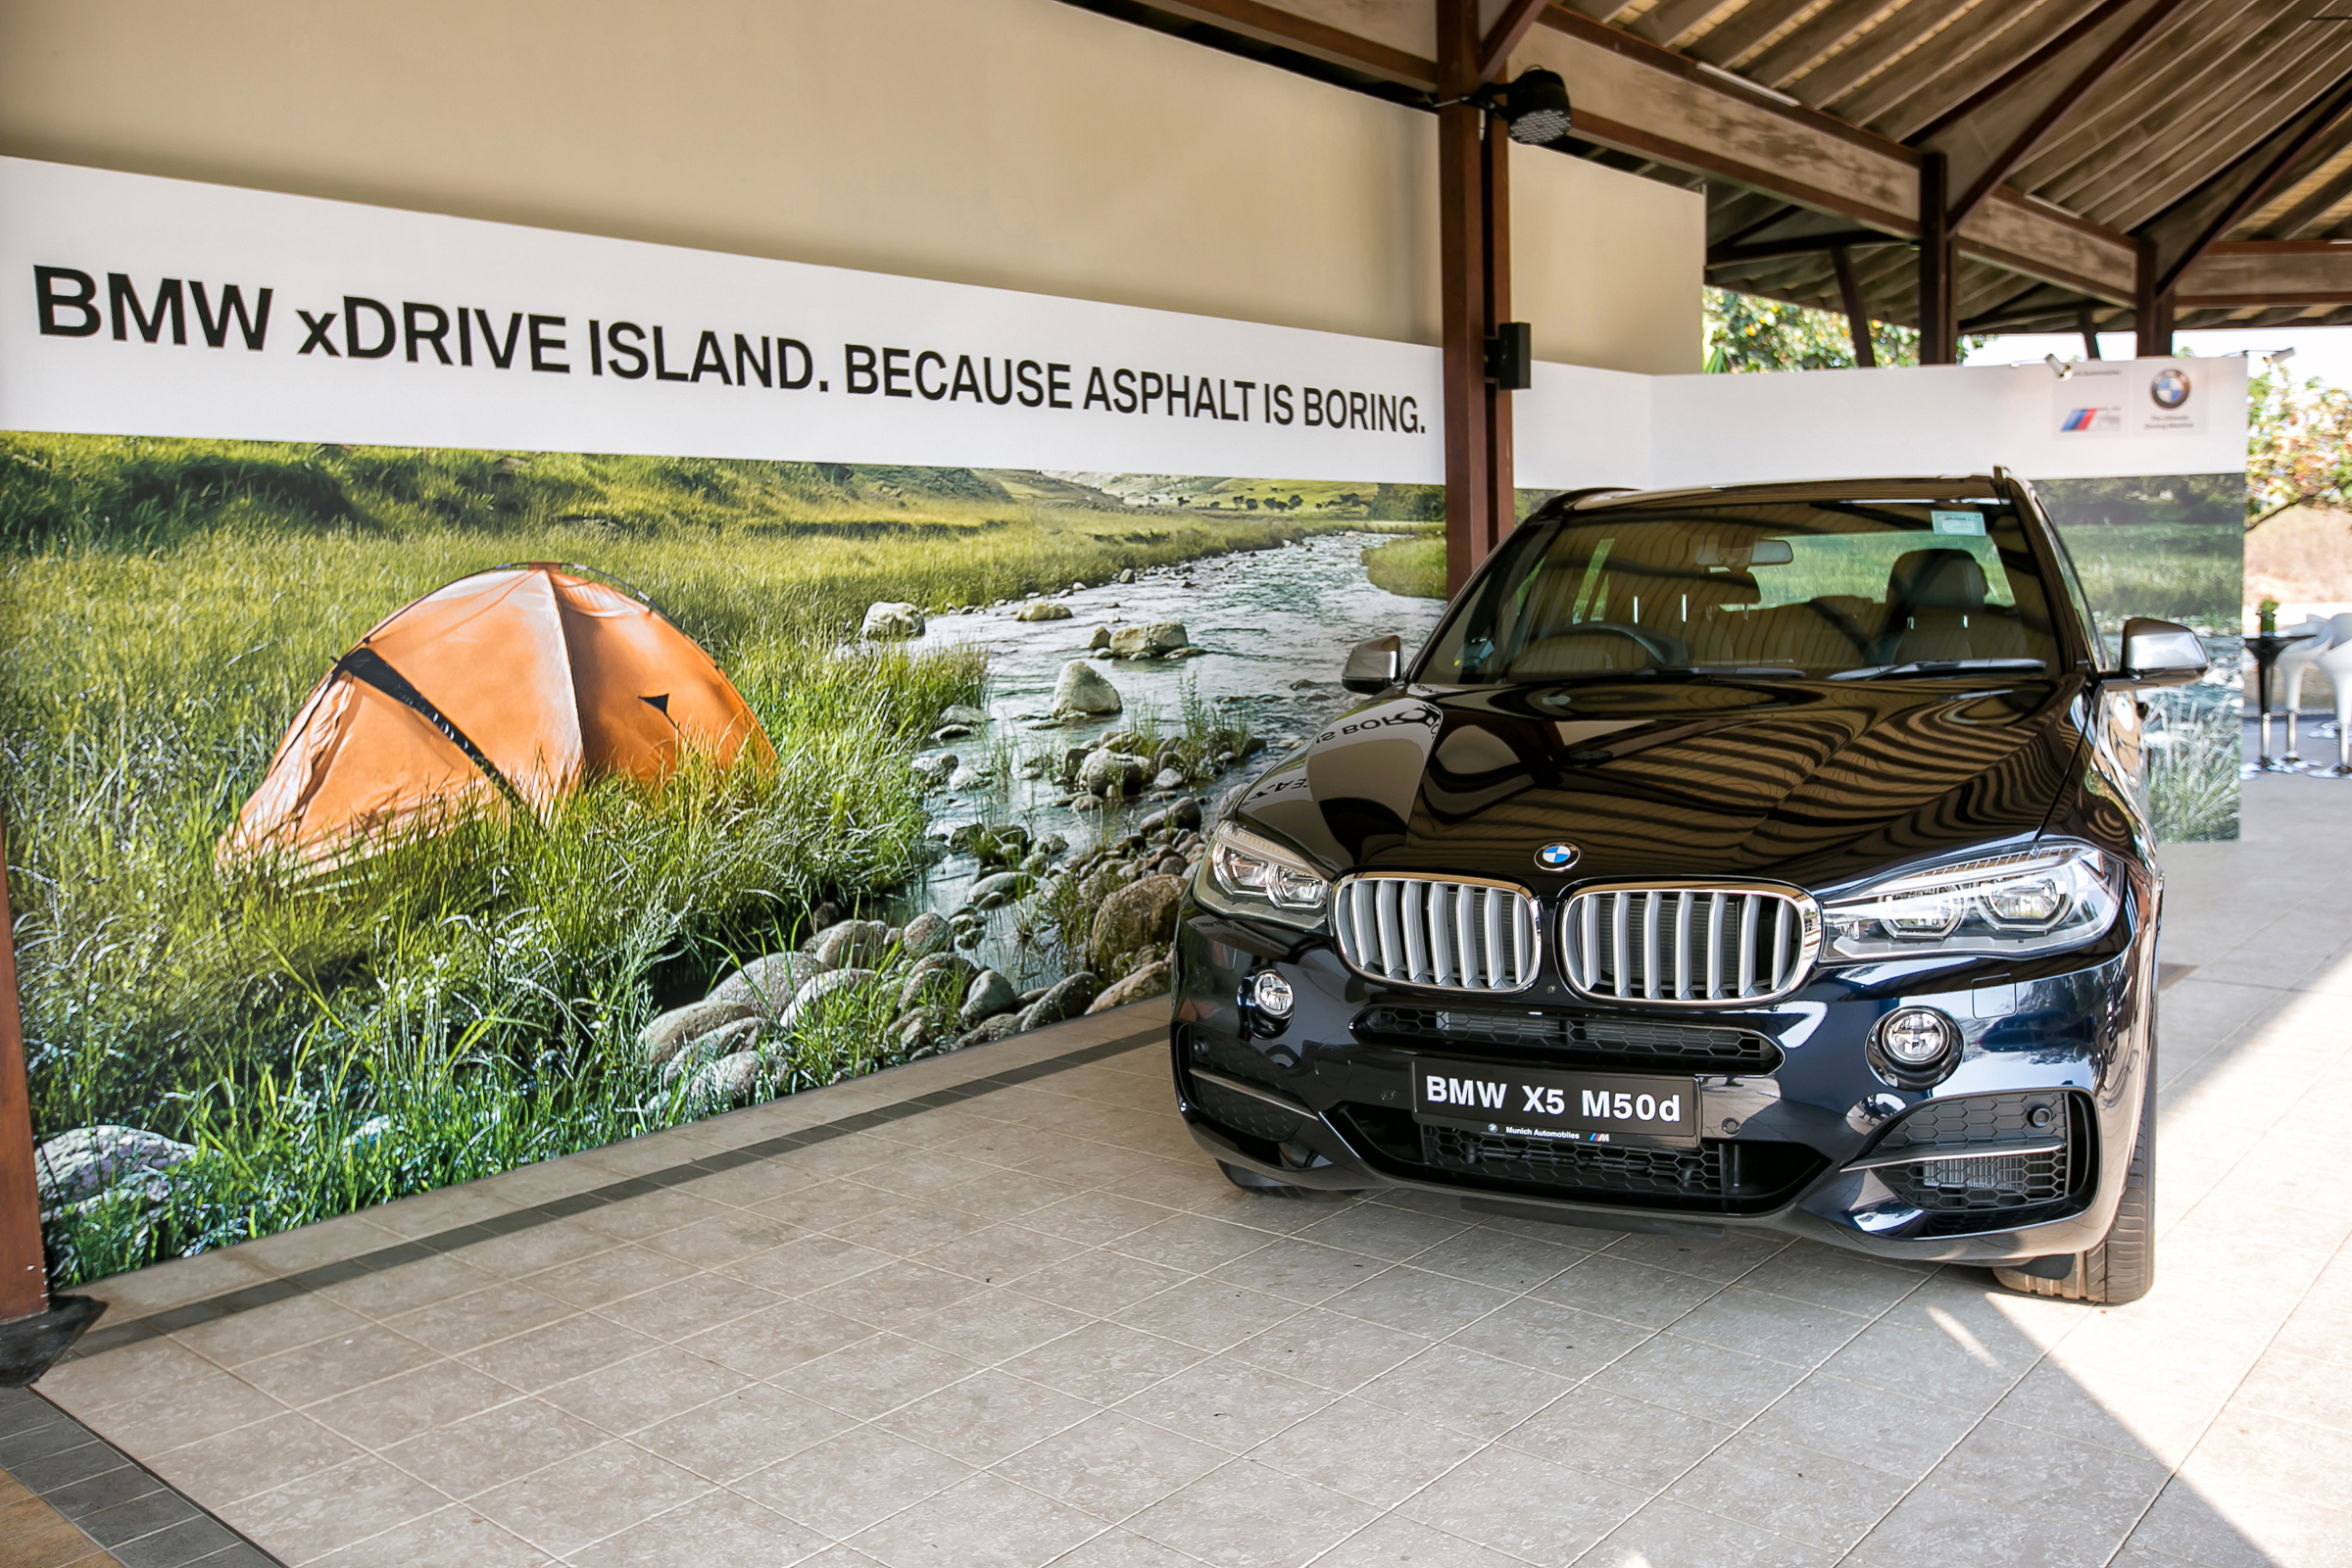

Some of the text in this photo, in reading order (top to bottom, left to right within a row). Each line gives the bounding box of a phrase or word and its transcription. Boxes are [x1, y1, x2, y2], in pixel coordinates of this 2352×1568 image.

[32, 264, 1427, 434] BMW xDRIVE ISLAND. BECAUSE ASPHALT IS BORING.
[1427, 1075, 1681, 1122] BMW X5 M50d
[1505, 1126, 1580, 1140] Munich Automobiles
